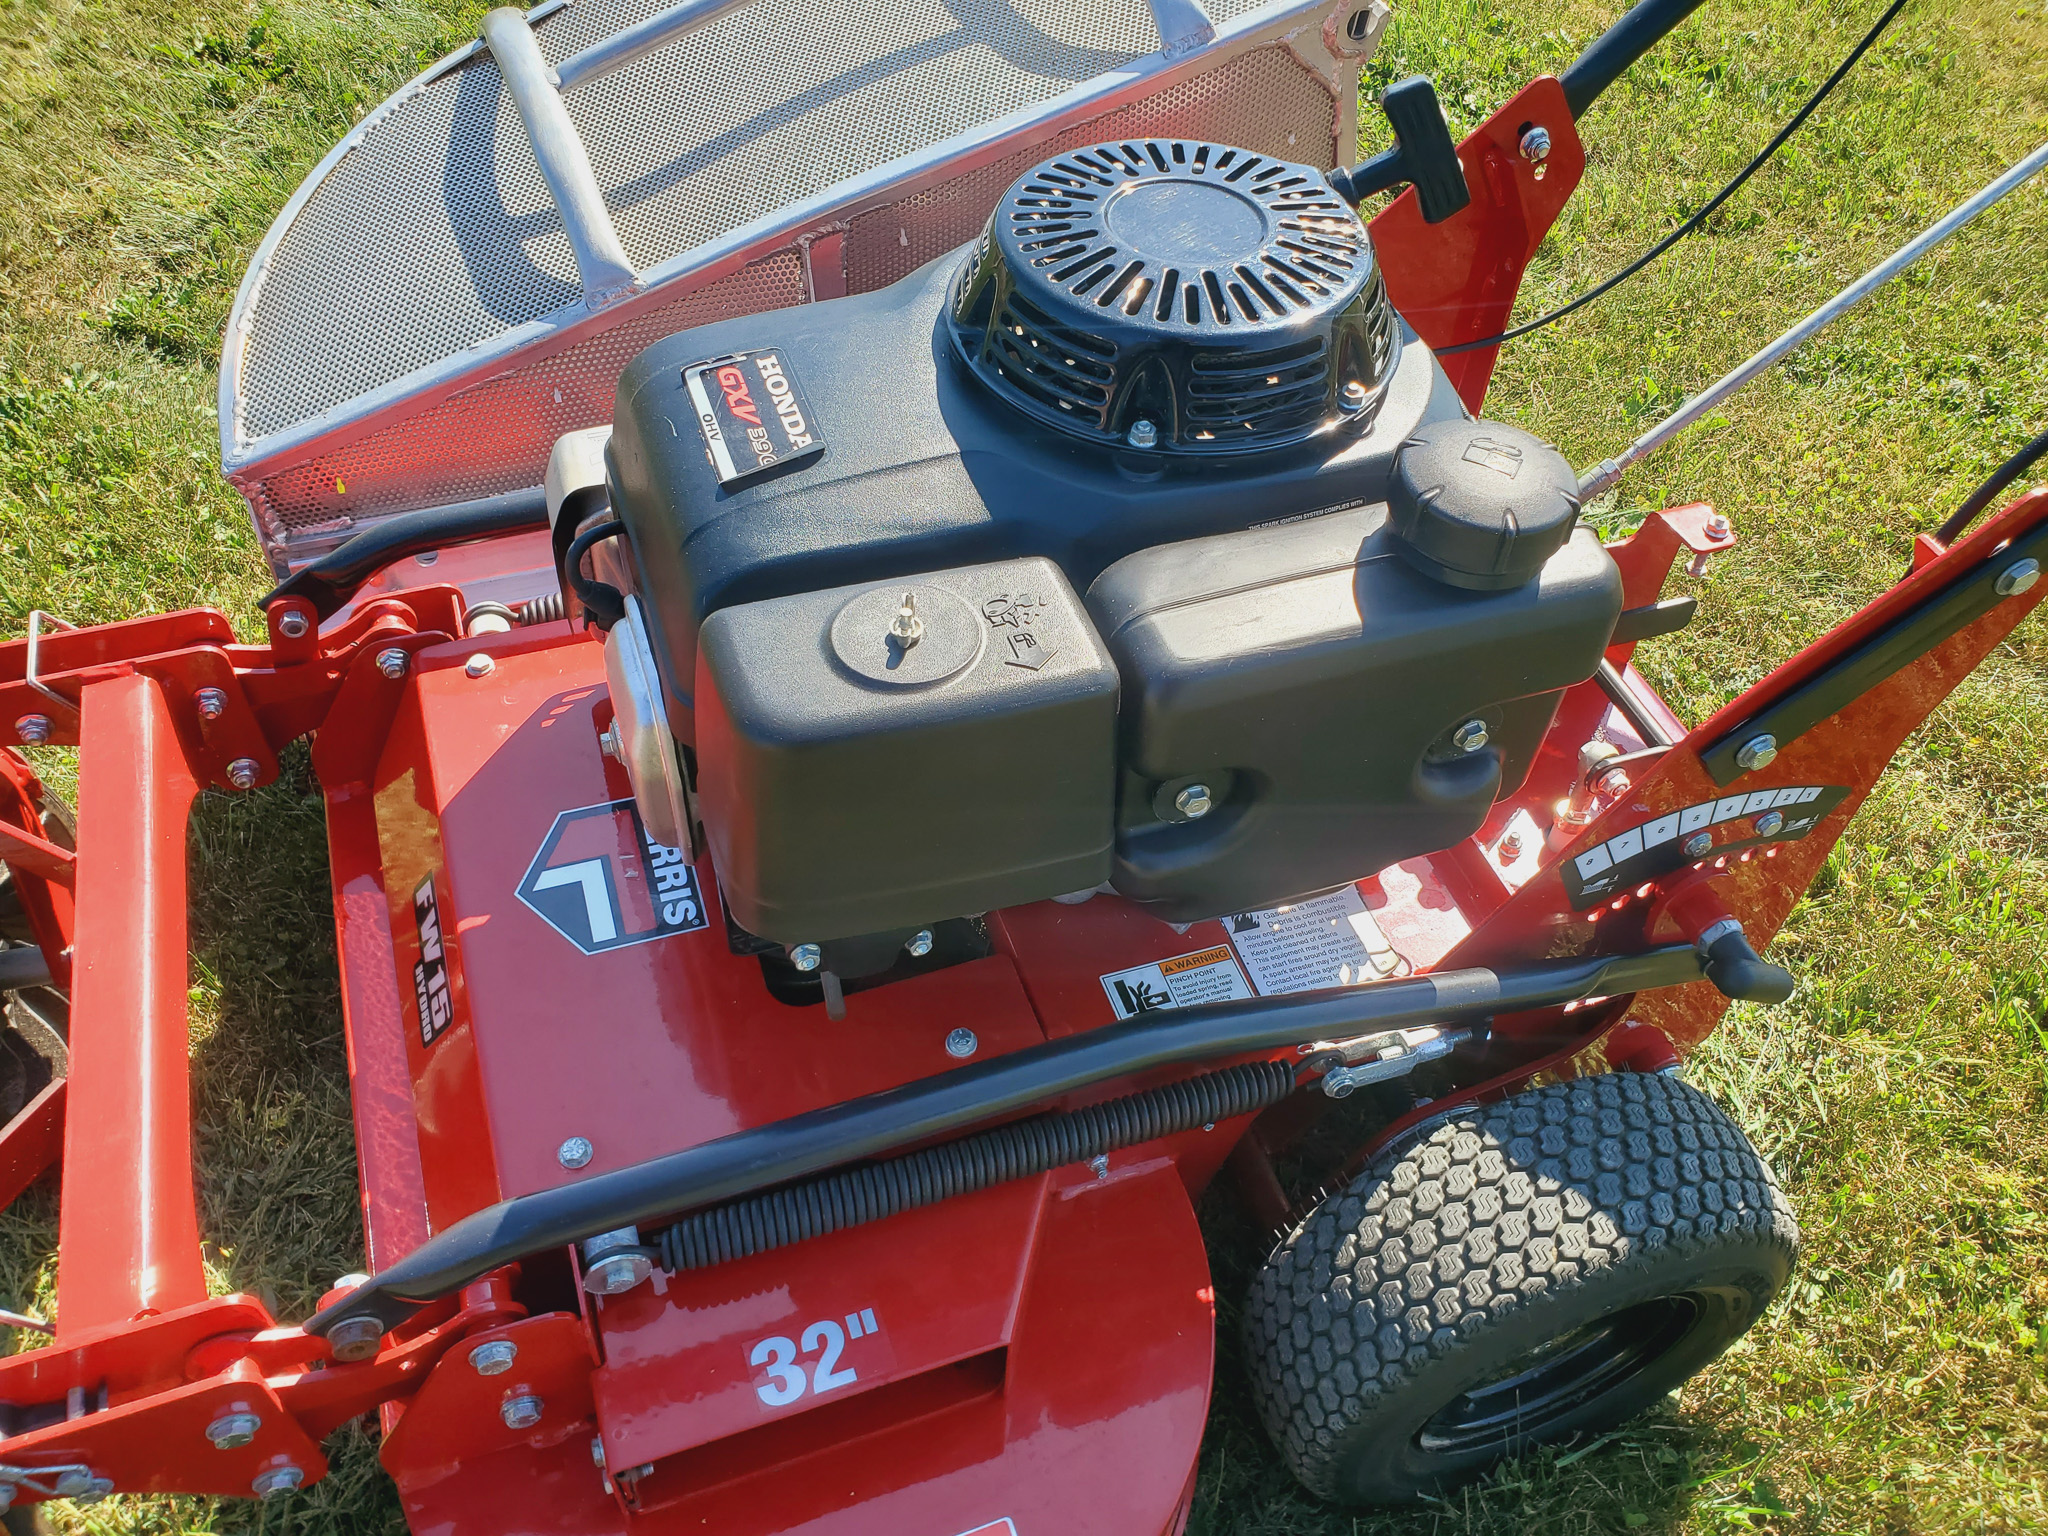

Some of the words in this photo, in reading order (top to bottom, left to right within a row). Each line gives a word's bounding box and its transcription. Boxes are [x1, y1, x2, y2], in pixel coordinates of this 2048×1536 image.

[717, 366, 763, 425] GXV
[756, 354, 813, 451] HONDA
[702, 413, 721, 441] OHV
[1261, 520, 1280, 529] SPARK
[1280, 514, 1303, 525] IGNITION
[1303, 509, 1324, 520] SYSTEM
[1324, 502, 1350, 514] COMPLIES
[1350, 499, 1364, 509] WITH
[1586, 858, 1593, 866] 8
[1621, 841, 1629, 849] 7
[1658, 826, 1665, 834] 6
[1693, 814, 1700, 822] 5
[1756, 798, 1763, 806] 3
[1783, 793, 1791, 801] 2
[644, 826, 697, 926] RRIS
[1306, 894, 1346, 908] flammable.
[1268, 917, 1293, 927] Debris
[1302, 904, 1348, 919] combustible.
[1243, 933, 1261, 942] Allow
[1262, 928, 1285, 938] engine
[1247, 939, 1272, 949] minutes
[1273, 934, 1294, 943] before
[1295, 926, 1326, 938] refueling.
[1251, 948, 1269, 957] Keep
[1283, 939, 1309, 948] cleaned
[1317, 931, 1338, 940] debris
[416, 879, 451, 1030] FW15
[1175, 950, 1227, 969] WARNING
[1254, 956, 1269, 964] This
[1270, 948, 1305, 961] equipment
[1320, 939, 1341, 948] create
[1304, 951, 1327, 960] around
[1170, 974, 1193, 984] PINCH
[1194, 968, 1217, 978] POINT
[1266, 977, 1292, 987] Contact
[1293, 972, 1308, 980] local
[1269, 969, 1288, 979] spark
[1289, 962, 1315, 972] arrester
[1316, 959, 1331, 967] may
[1177, 989, 1197, 997] loaded
[1198, 984, 1219, 992] spring,
[1199, 977, 1216, 985] injury
[1270, 981, 1307, 995] regulations
[1308, 975, 1333, 986] relating
[415, 964, 433, 1043] HYDRO
[1179, 993, 1210, 1004] operator's
[1210, 987, 1232, 995] manual
[750, 1308, 879, 1406] 32"
